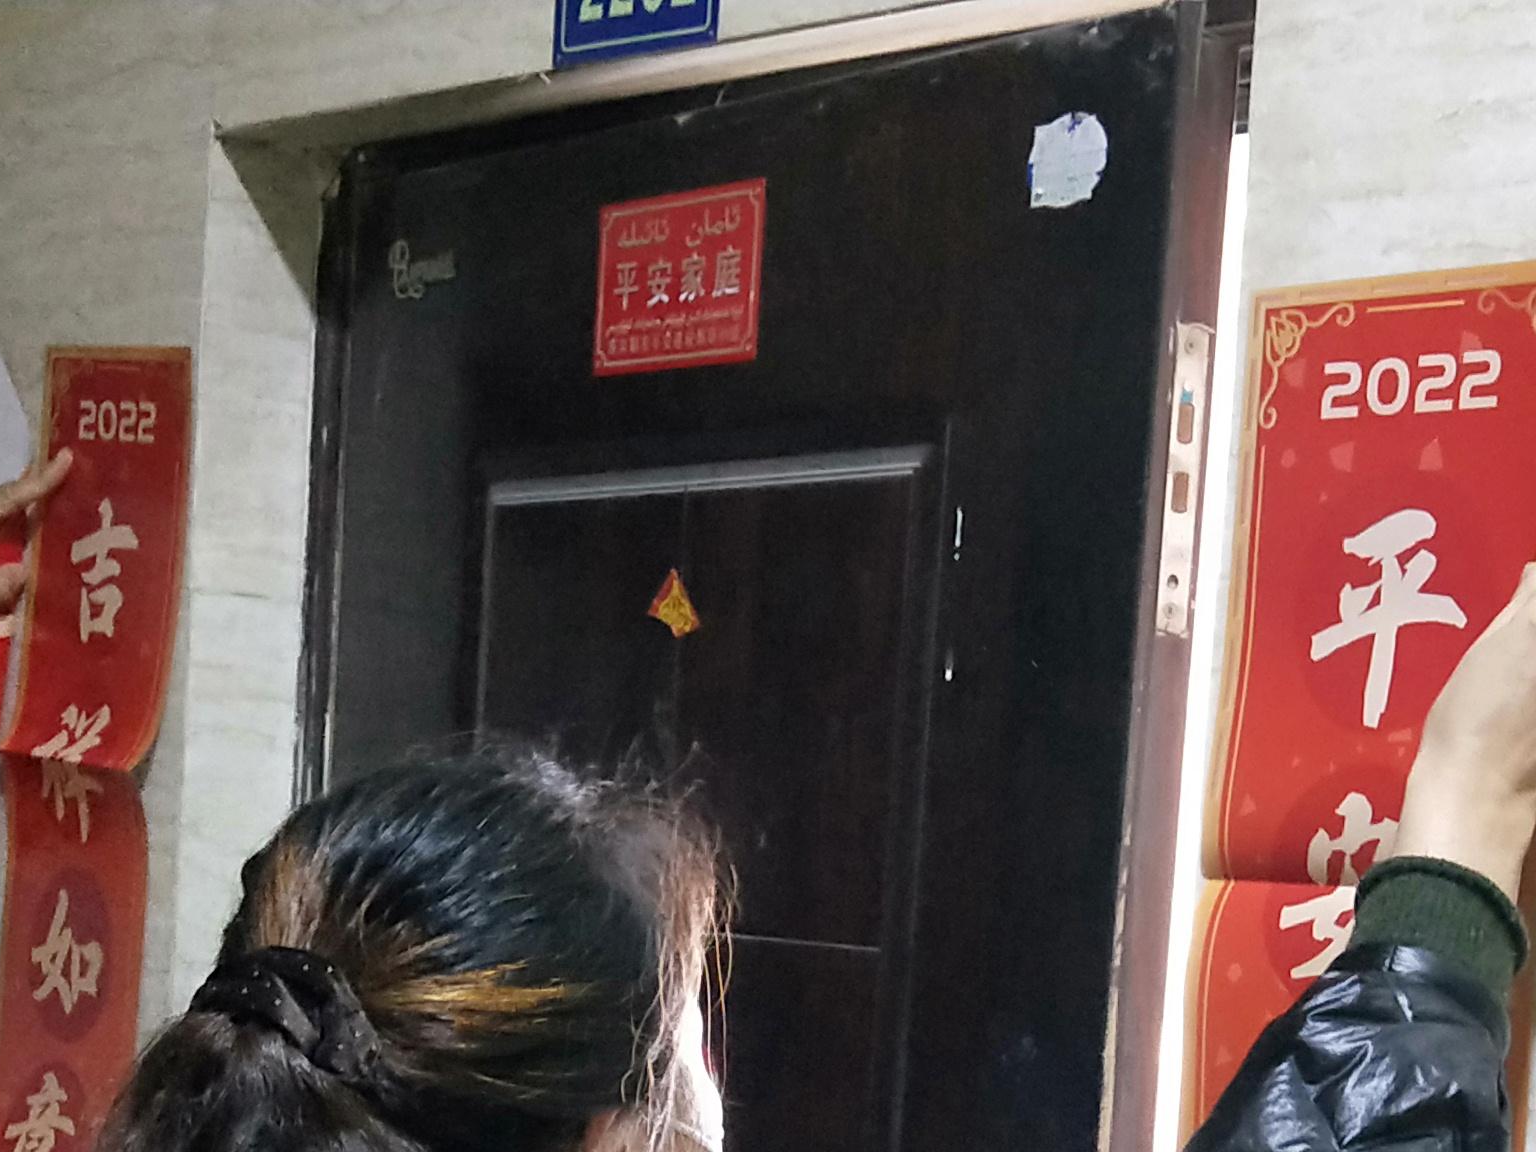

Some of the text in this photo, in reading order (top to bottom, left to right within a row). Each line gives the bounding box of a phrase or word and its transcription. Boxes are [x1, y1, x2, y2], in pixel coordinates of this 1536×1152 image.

[614, 245, 742, 311] 平安家庭
[1320, 349, 1503, 420] 2022
[78, 401, 156, 444] 2022
